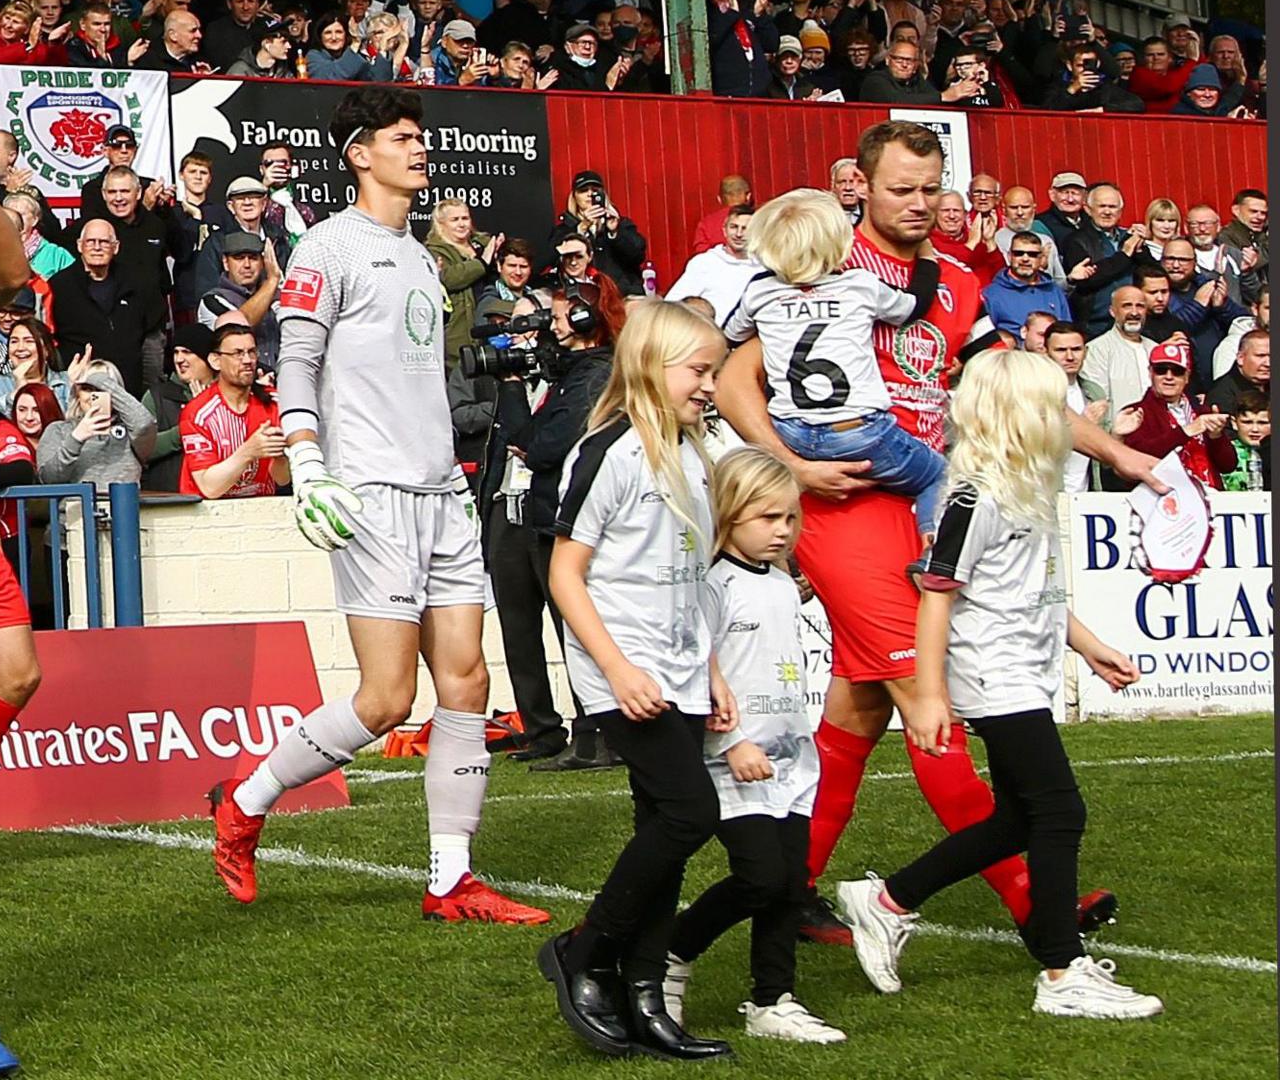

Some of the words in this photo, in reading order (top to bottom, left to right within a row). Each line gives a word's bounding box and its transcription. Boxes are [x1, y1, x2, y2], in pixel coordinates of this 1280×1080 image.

[21, 70, 94, 88] PRIDE
[101, 71, 132, 88] OF
[240, 121, 322, 148] Falcon
[439, 127, 537, 160] Flooring
[428, 161, 517, 177] pecialists
[296, 183, 337, 204] Tel.
[781, 300, 841, 319] TATE
[785, 323, 851, 411] 6
[1164, 650, 1274, 675] WINDO
[127, 710, 199, 763] FA
[200, 703, 305, 759] CUP
